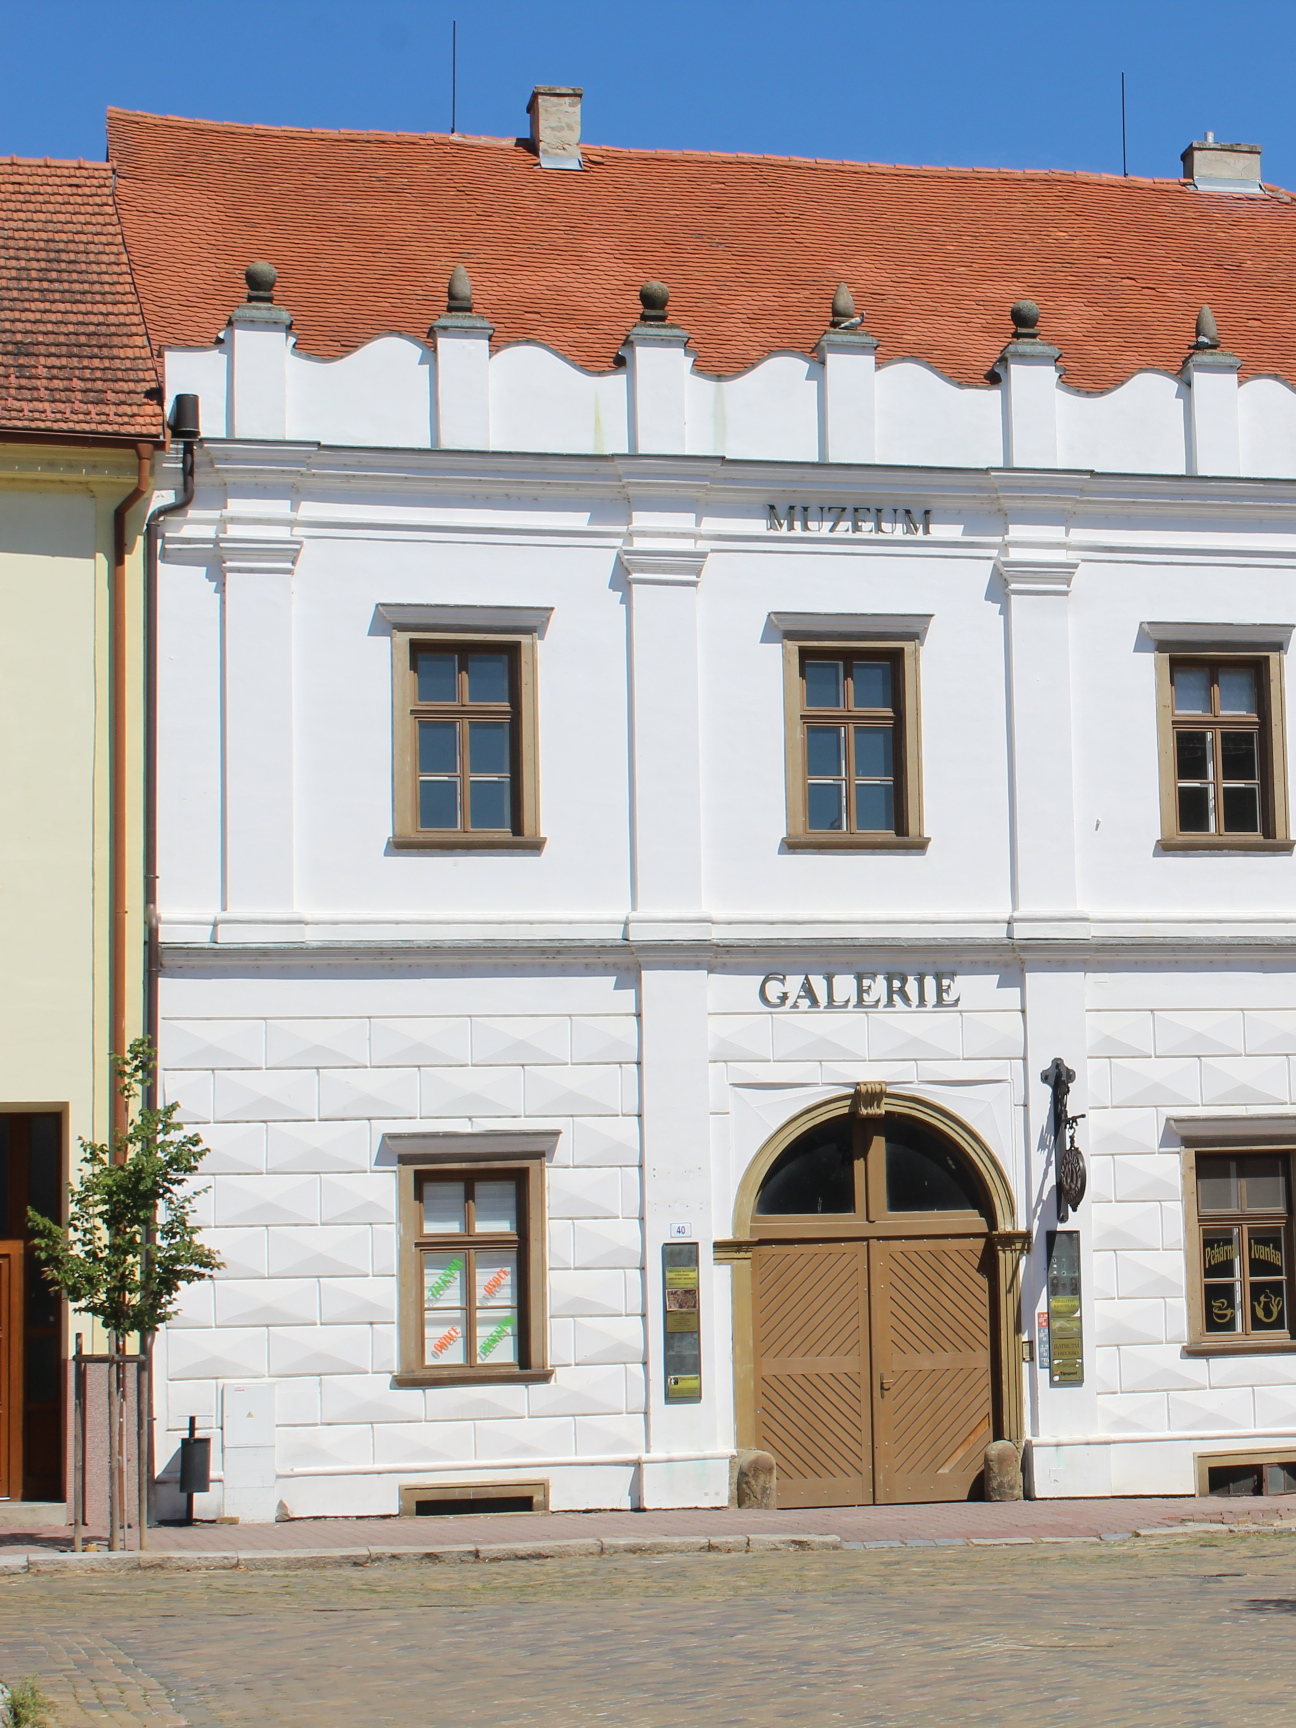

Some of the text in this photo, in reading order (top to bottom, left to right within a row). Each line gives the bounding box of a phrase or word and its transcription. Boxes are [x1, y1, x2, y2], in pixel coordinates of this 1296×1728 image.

[767, 504, 932, 535] MUZEUM
[759, 971, 961, 1009] GALERIE
[676, 1225, 685, 1235] 40
[1251, 1239, 1282, 1266] Ivanka
[483, 1267, 510, 1295] OVOCE
[433, 1326, 460, 1354] OVOCE
